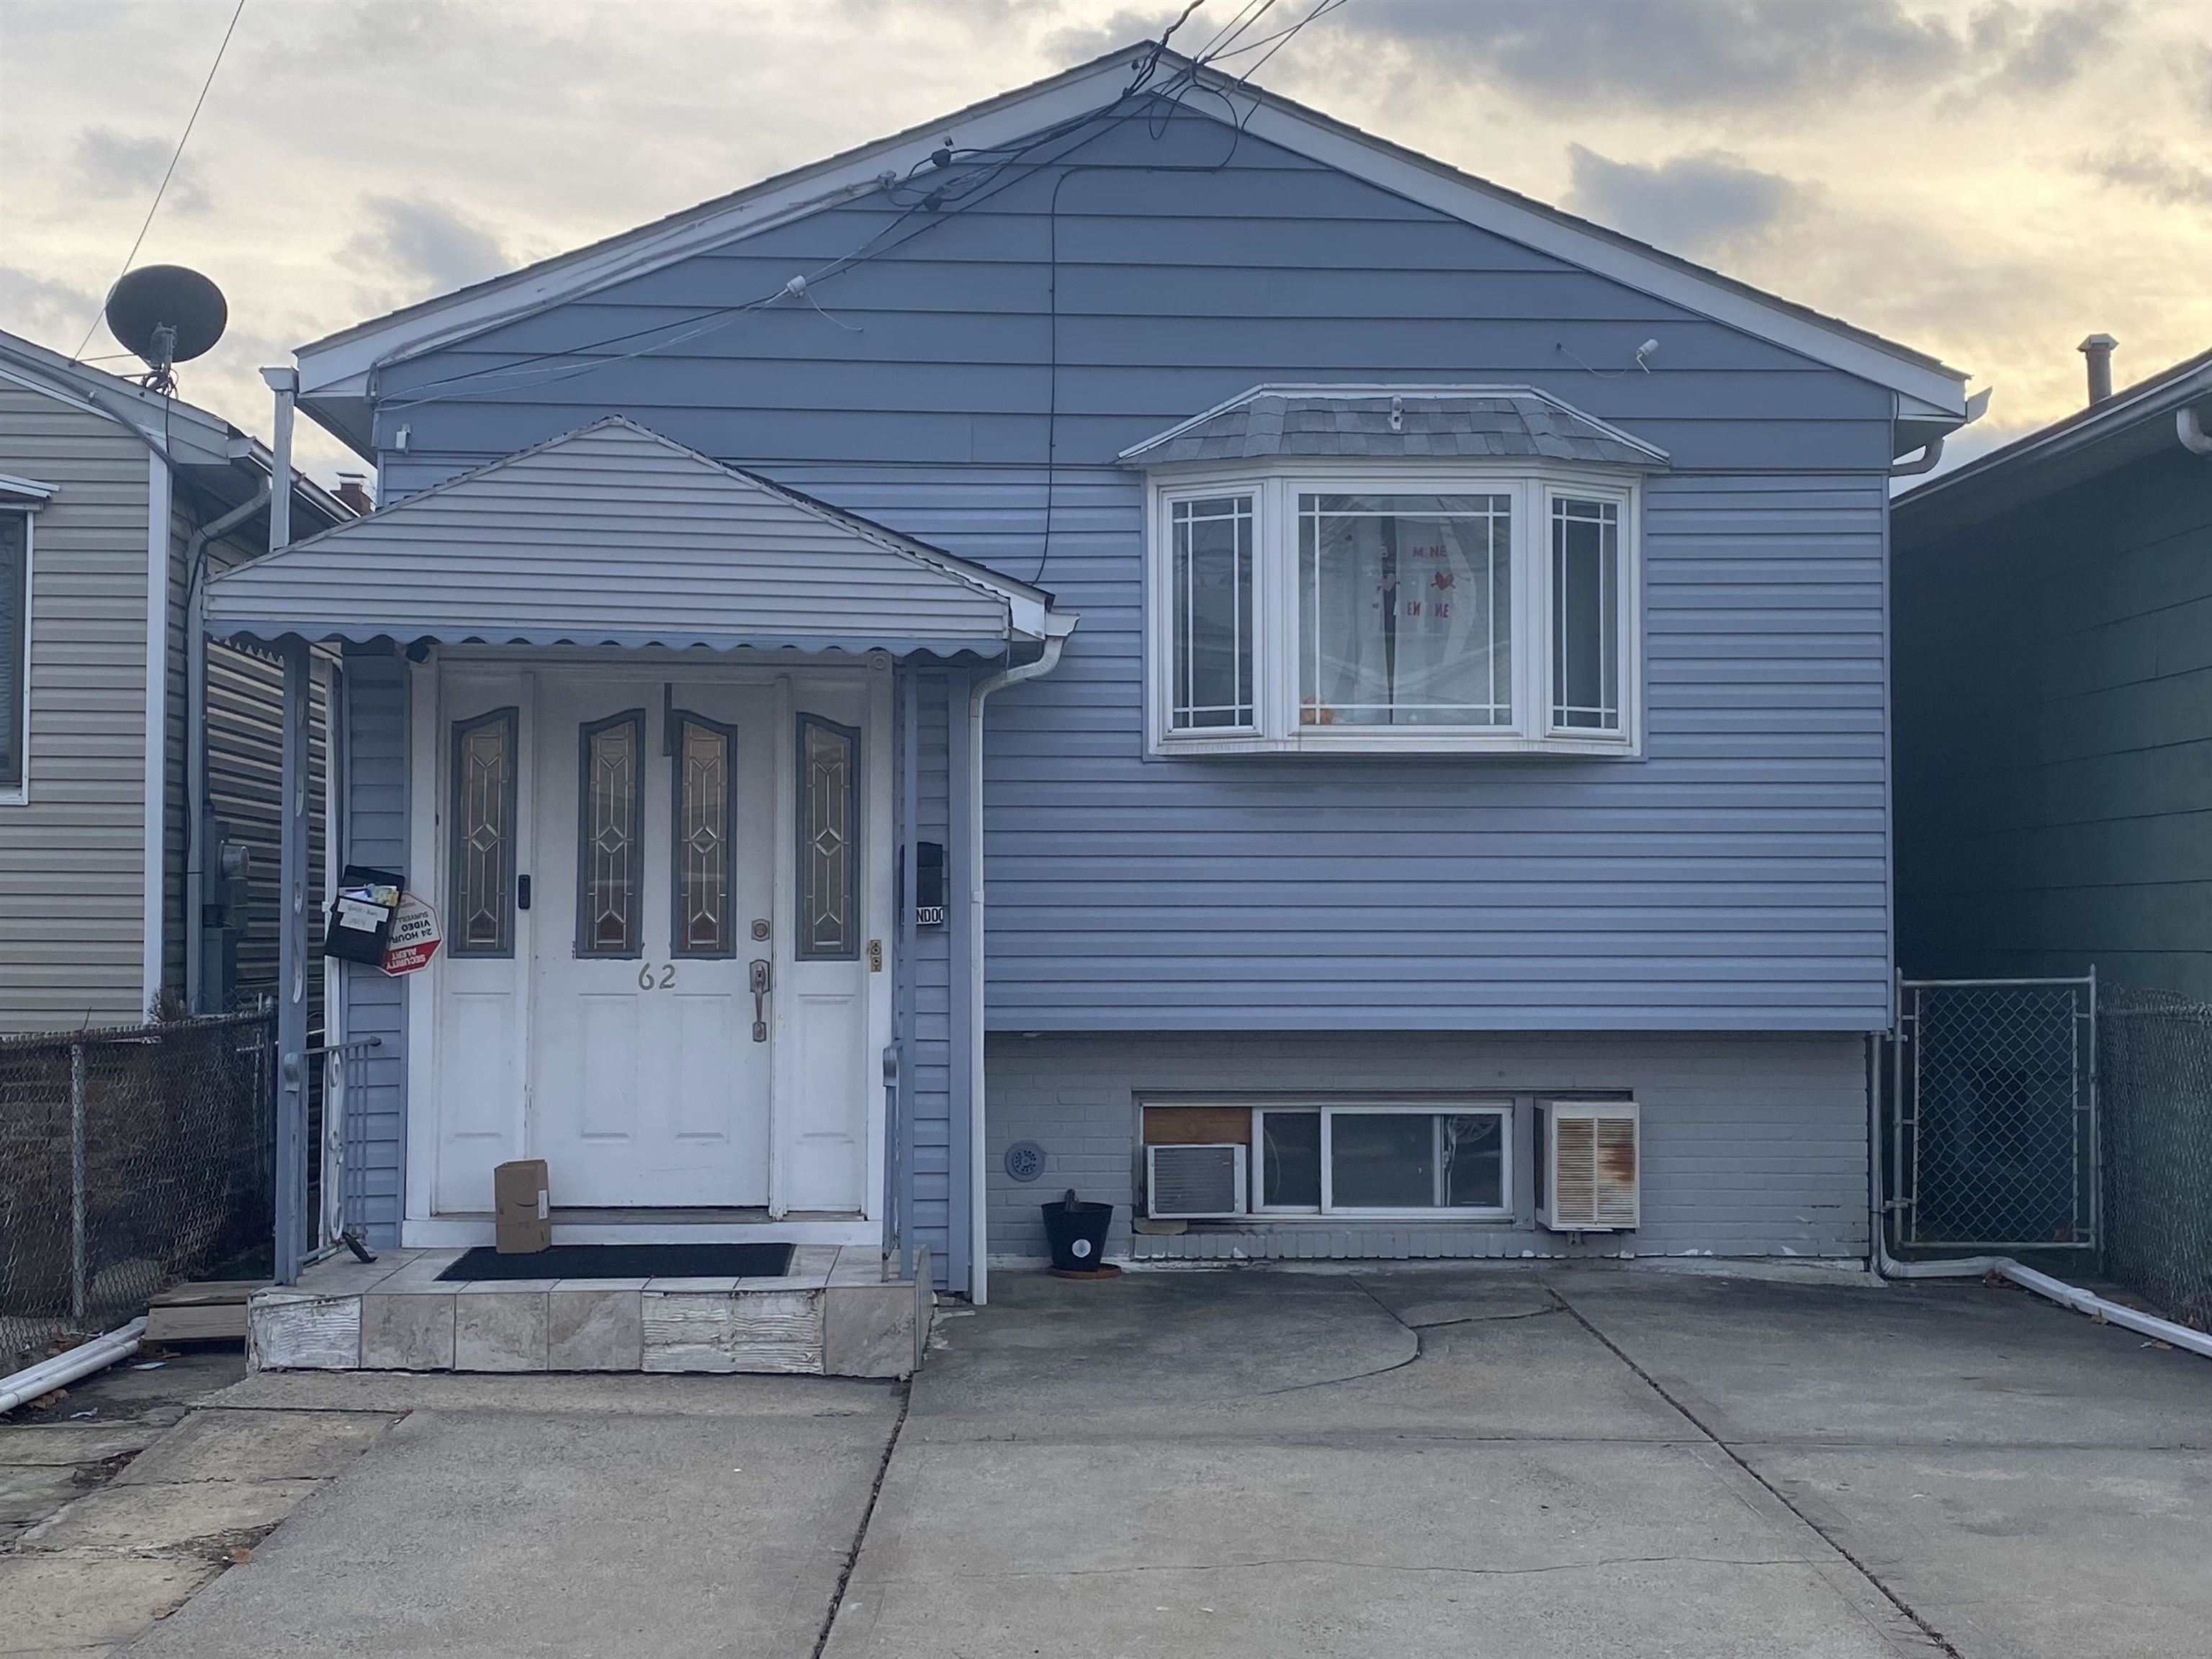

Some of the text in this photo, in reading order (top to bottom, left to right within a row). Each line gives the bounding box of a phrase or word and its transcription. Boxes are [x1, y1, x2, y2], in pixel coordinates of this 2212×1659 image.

[401, 920, 431, 932] VIDEO
[392, 928, 433, 943] 24 HOUR
[386, 954, 426, 970] SECURITY
[391, 948, 417, 961] ALERT
[639, 962, 675, 990] 62
